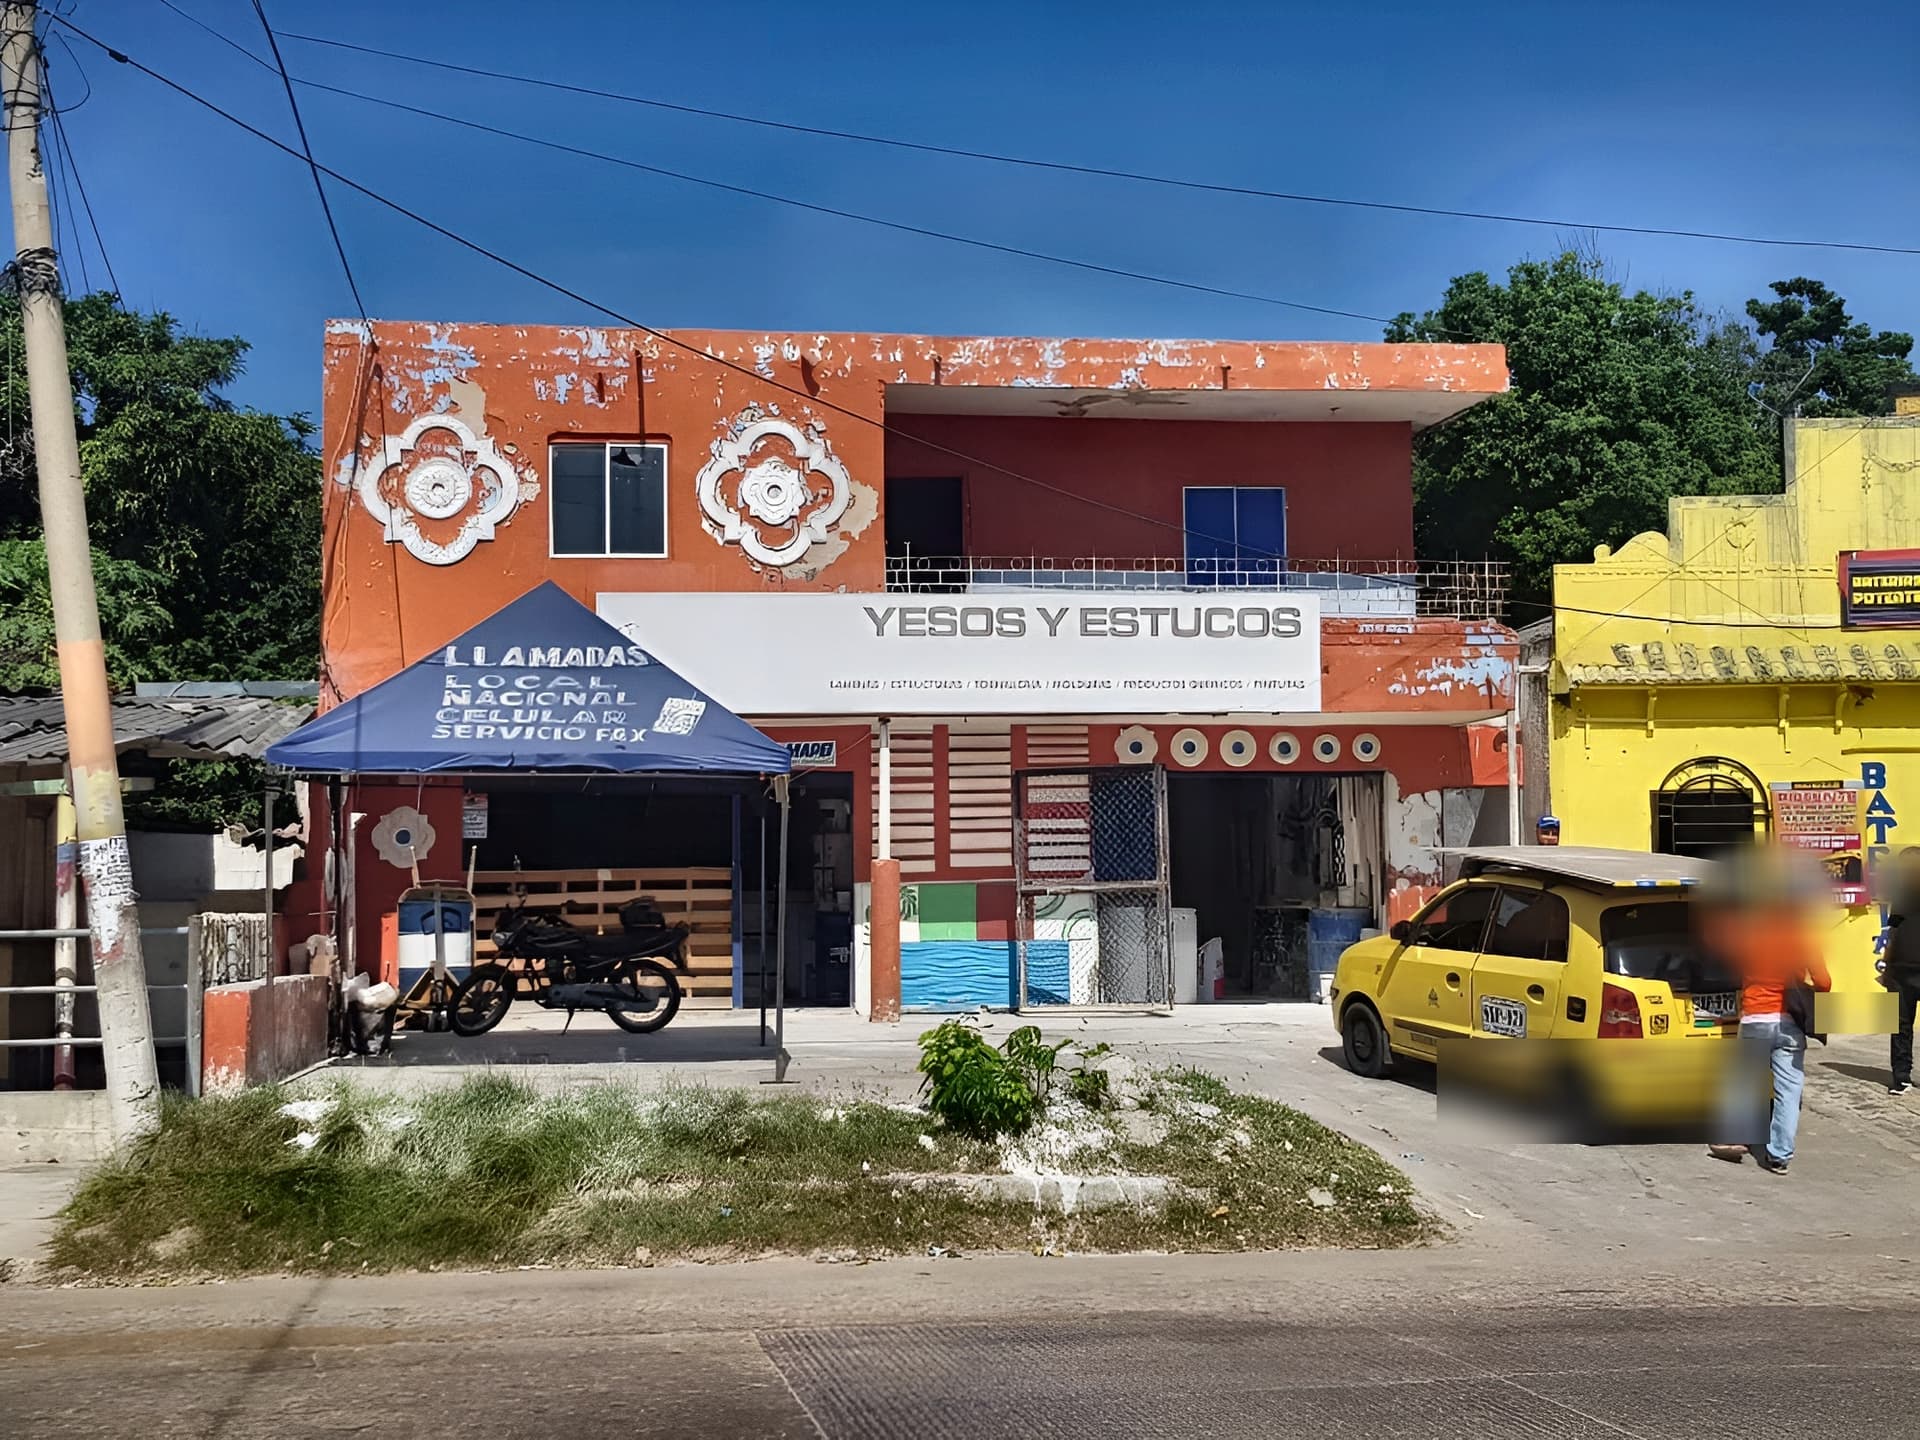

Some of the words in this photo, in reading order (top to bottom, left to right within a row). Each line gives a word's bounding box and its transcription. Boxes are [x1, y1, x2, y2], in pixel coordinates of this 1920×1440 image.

[863, 607, 1027, 638] YESOS
[1036, 607, 1070, 638] Y
[1079, 607, 1302, 639] ESTUCOS
[444, 645, 649, 668] LLAMADAS
[445, 674, 617, 690] LOCAL
[442, 690, 638, 707] NACIONAL
[435, 708, 628, 724] CELULAR
[431, 724, 587, 741] SERVICIO
